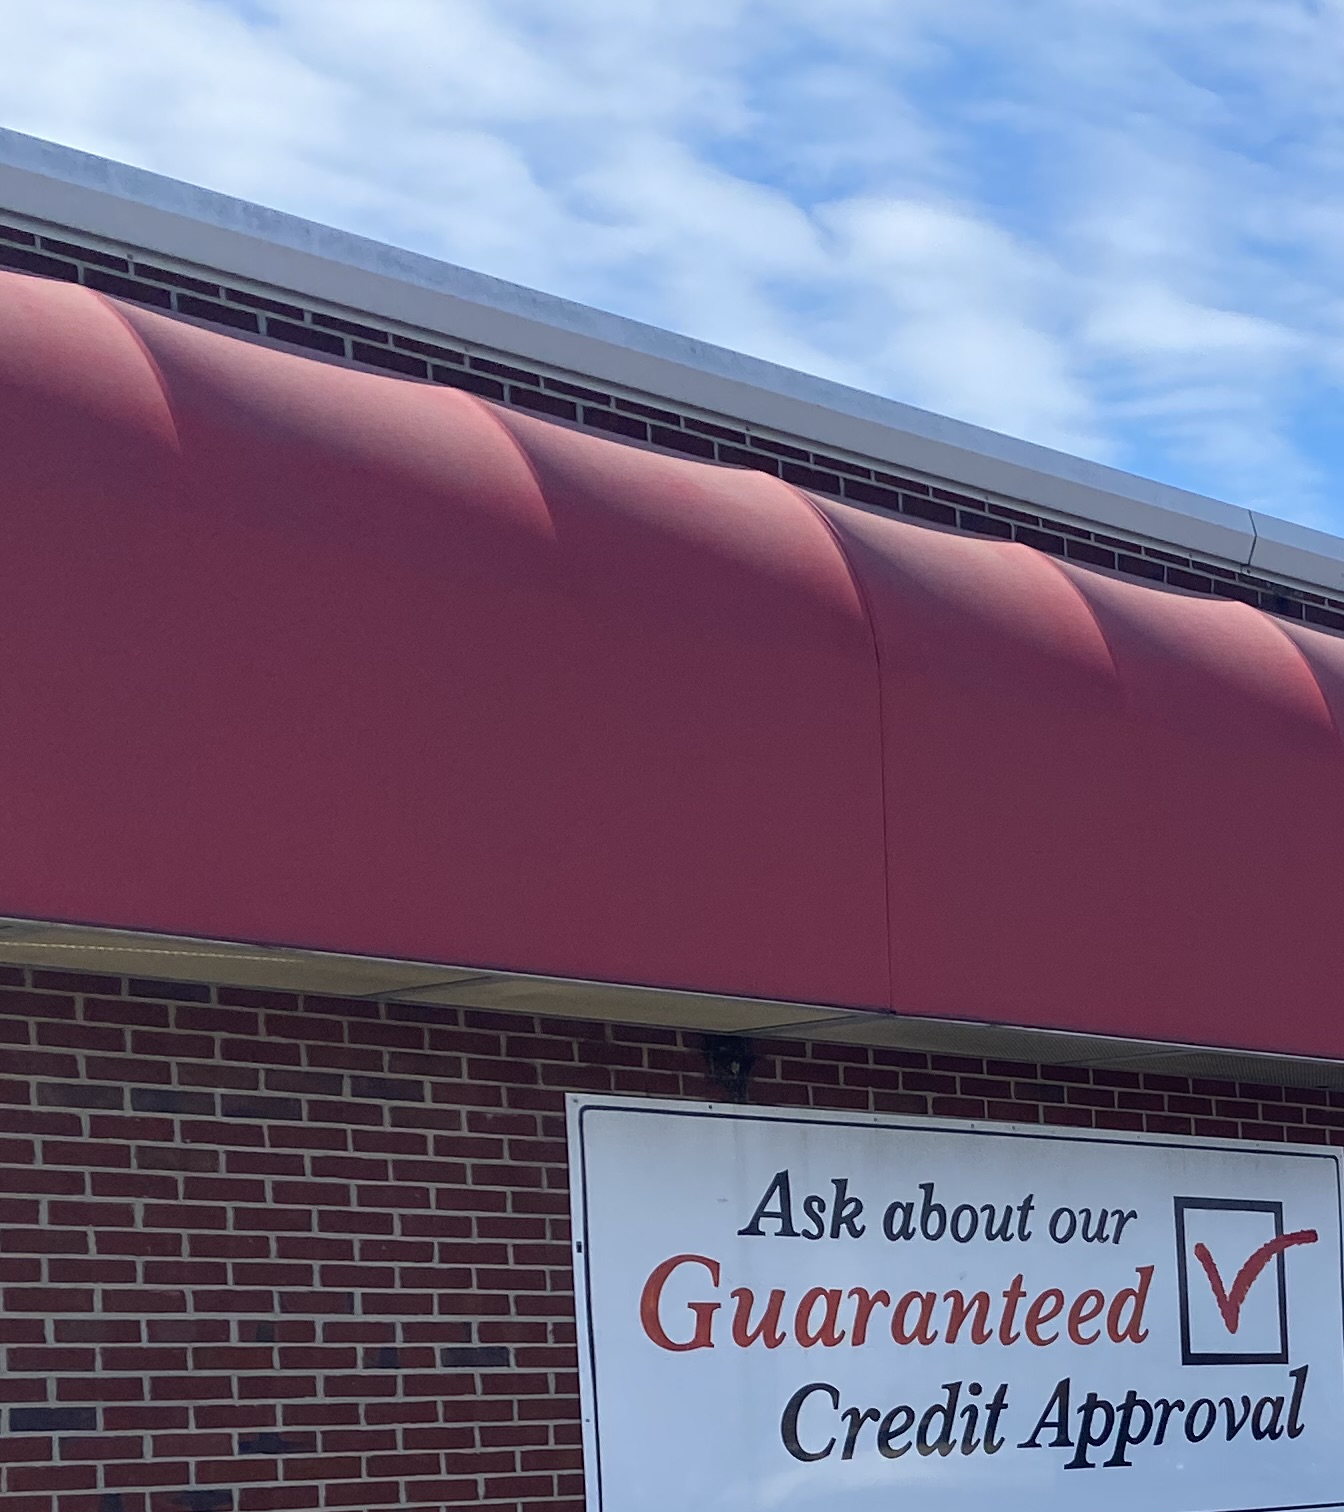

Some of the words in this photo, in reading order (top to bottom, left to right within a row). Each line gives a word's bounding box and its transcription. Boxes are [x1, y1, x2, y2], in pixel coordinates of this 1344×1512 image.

[737, 1168, 867, 1242] Ask
[883, 1182, 1036, 1244] about
[1048, 1203, 1138, 1246] our
[639, 1253, 1156, 1354] Guaranteed
[780, 1379, 1009, 1464] Credit
[1017, 1364, 1310, 1470] Approval
